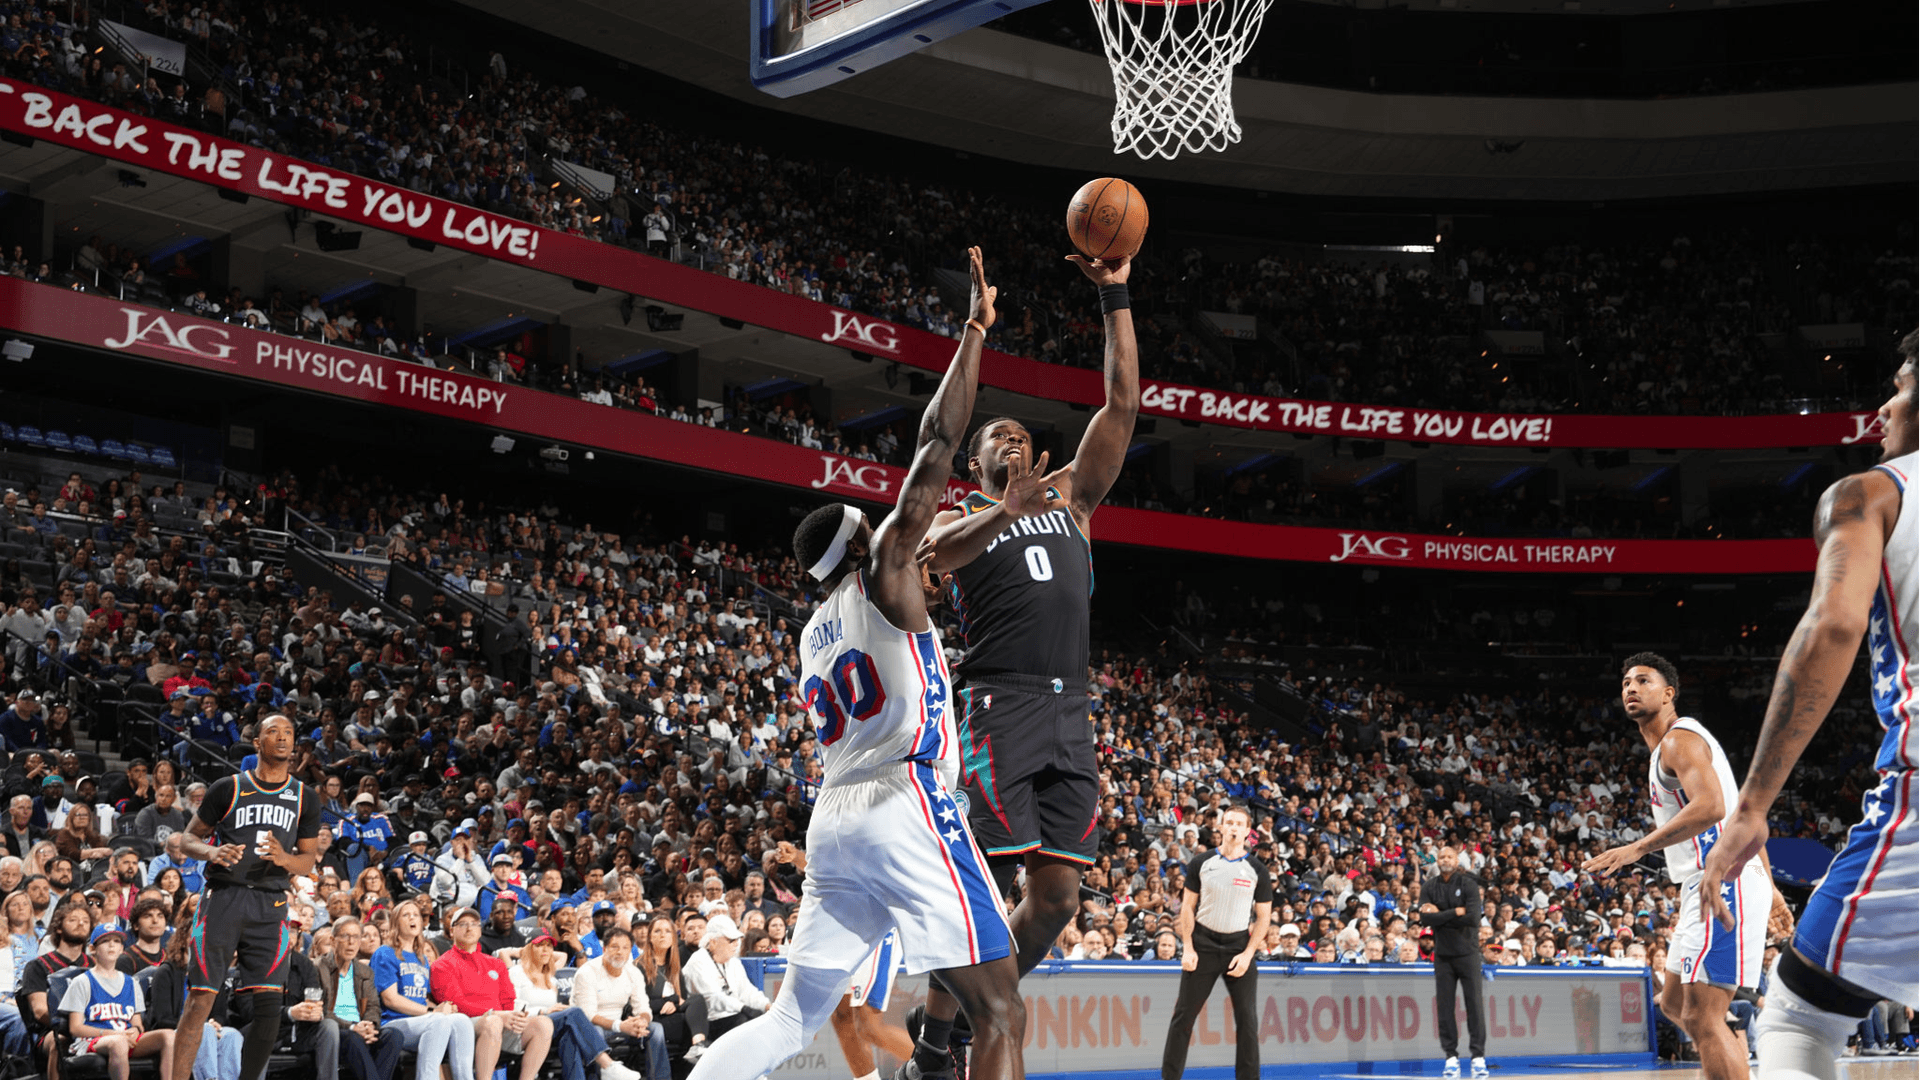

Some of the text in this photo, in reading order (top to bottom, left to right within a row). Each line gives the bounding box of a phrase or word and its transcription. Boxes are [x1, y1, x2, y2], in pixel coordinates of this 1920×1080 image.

[156, 57, 180, 74] 224
[21, 92, 539, 260] BACK THE LIFE YOU LOVE!
[821, 310, 899, 353] JAG
[104, 307, 507, 414] JAG PHYSICAL THERAPY
[1141, 384, 1552, 441] GET BACK THE LIFE YOU LOVE!
[1842, 414, 1887, 444] JA
[811, 456, 891, 492] JAG
[1025, 545, 1053, 581] 0
[1330, 533, 1615, 563] JAG PHYSICAL THERAPY
[809, 618, 843, 659] BONA
[804, 648, 887, 747] 30
[235, 804, 297, 832] DETROIT
[1022, 995, 1151, 1050] NKIN'
[1258, 994, 1420, 1043] AROUND
[776, 1052, 827, 1071] YOTA
